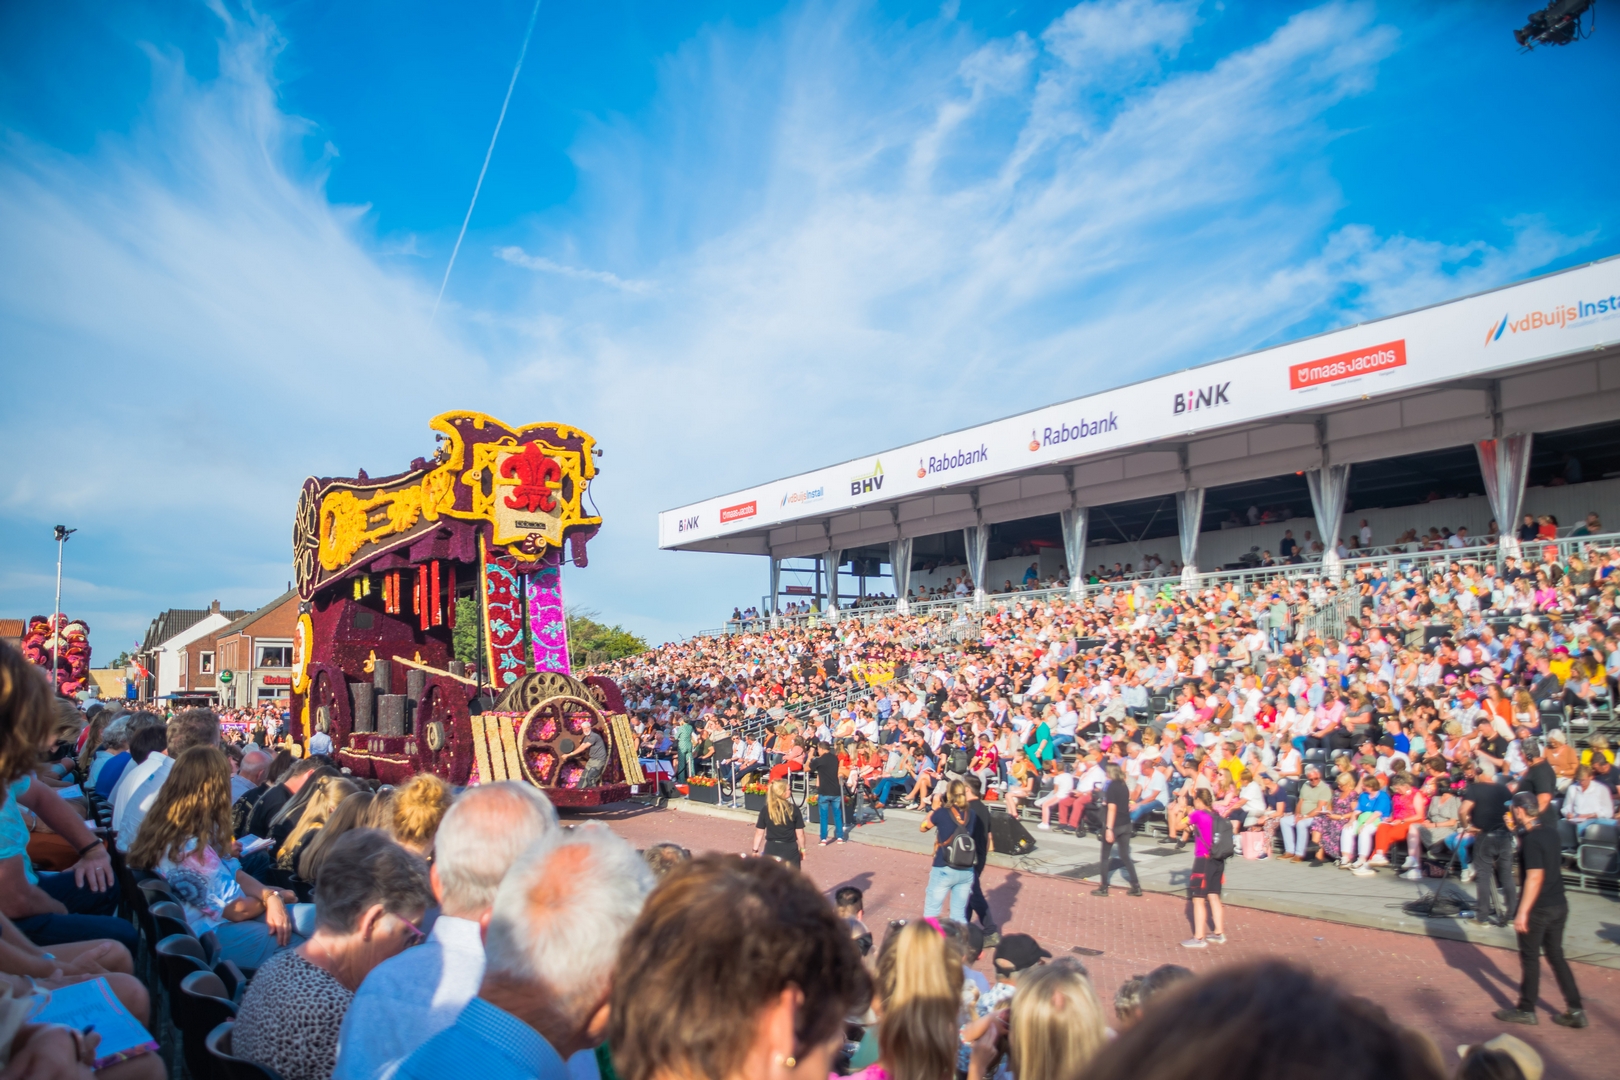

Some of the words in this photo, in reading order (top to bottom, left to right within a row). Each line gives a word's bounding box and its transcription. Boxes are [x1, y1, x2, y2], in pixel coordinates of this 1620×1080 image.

[1508, 294, 1620, 334] vdBuijsInst
[1043, 411, 1118, 446] Rabobank
[928, 443, 988, 474] Rabobank
[851, 474, 884, 496] BHV
